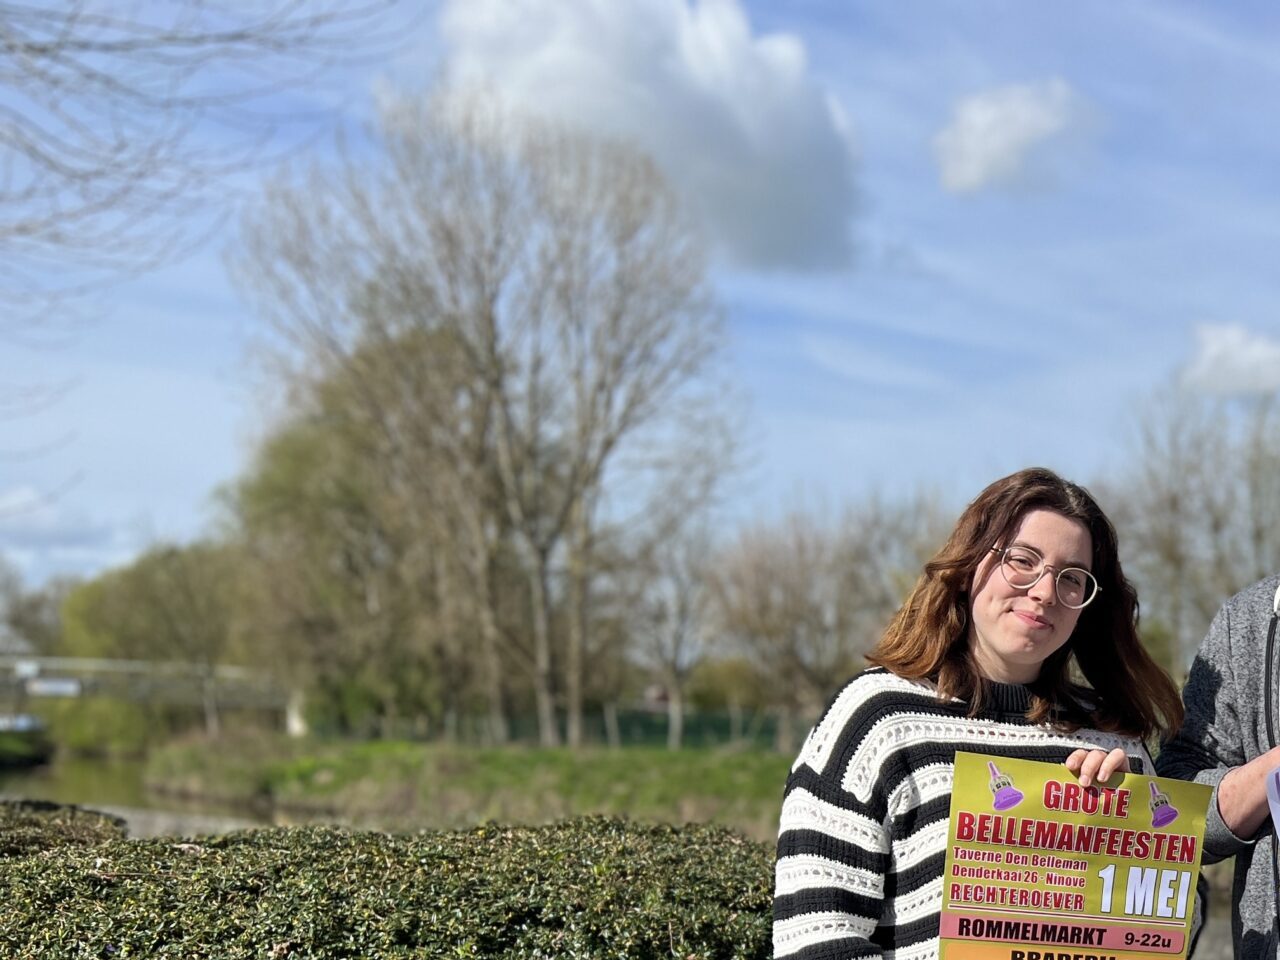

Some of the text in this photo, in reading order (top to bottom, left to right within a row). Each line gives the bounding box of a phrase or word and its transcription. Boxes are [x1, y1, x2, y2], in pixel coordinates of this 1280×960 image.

[1043, 780, 1131, 818] GROTE
[956, 811, 1197, 864] BELLEMANFEESTEN
[953, 847, 1088, 871] Taverne Den Belleman
[951, 864, 1023, 883] Denderkaai
[1023, 870, 1038, 884] 26
[1045, 871, 1086, 888] Ninove
[950, 883, 1084, 911] RECHTEROEVER
[1098, 864, 1191, 919] 1 MEI
[958, 918, 1172, 948] ROMMELMARKT 9-22u
